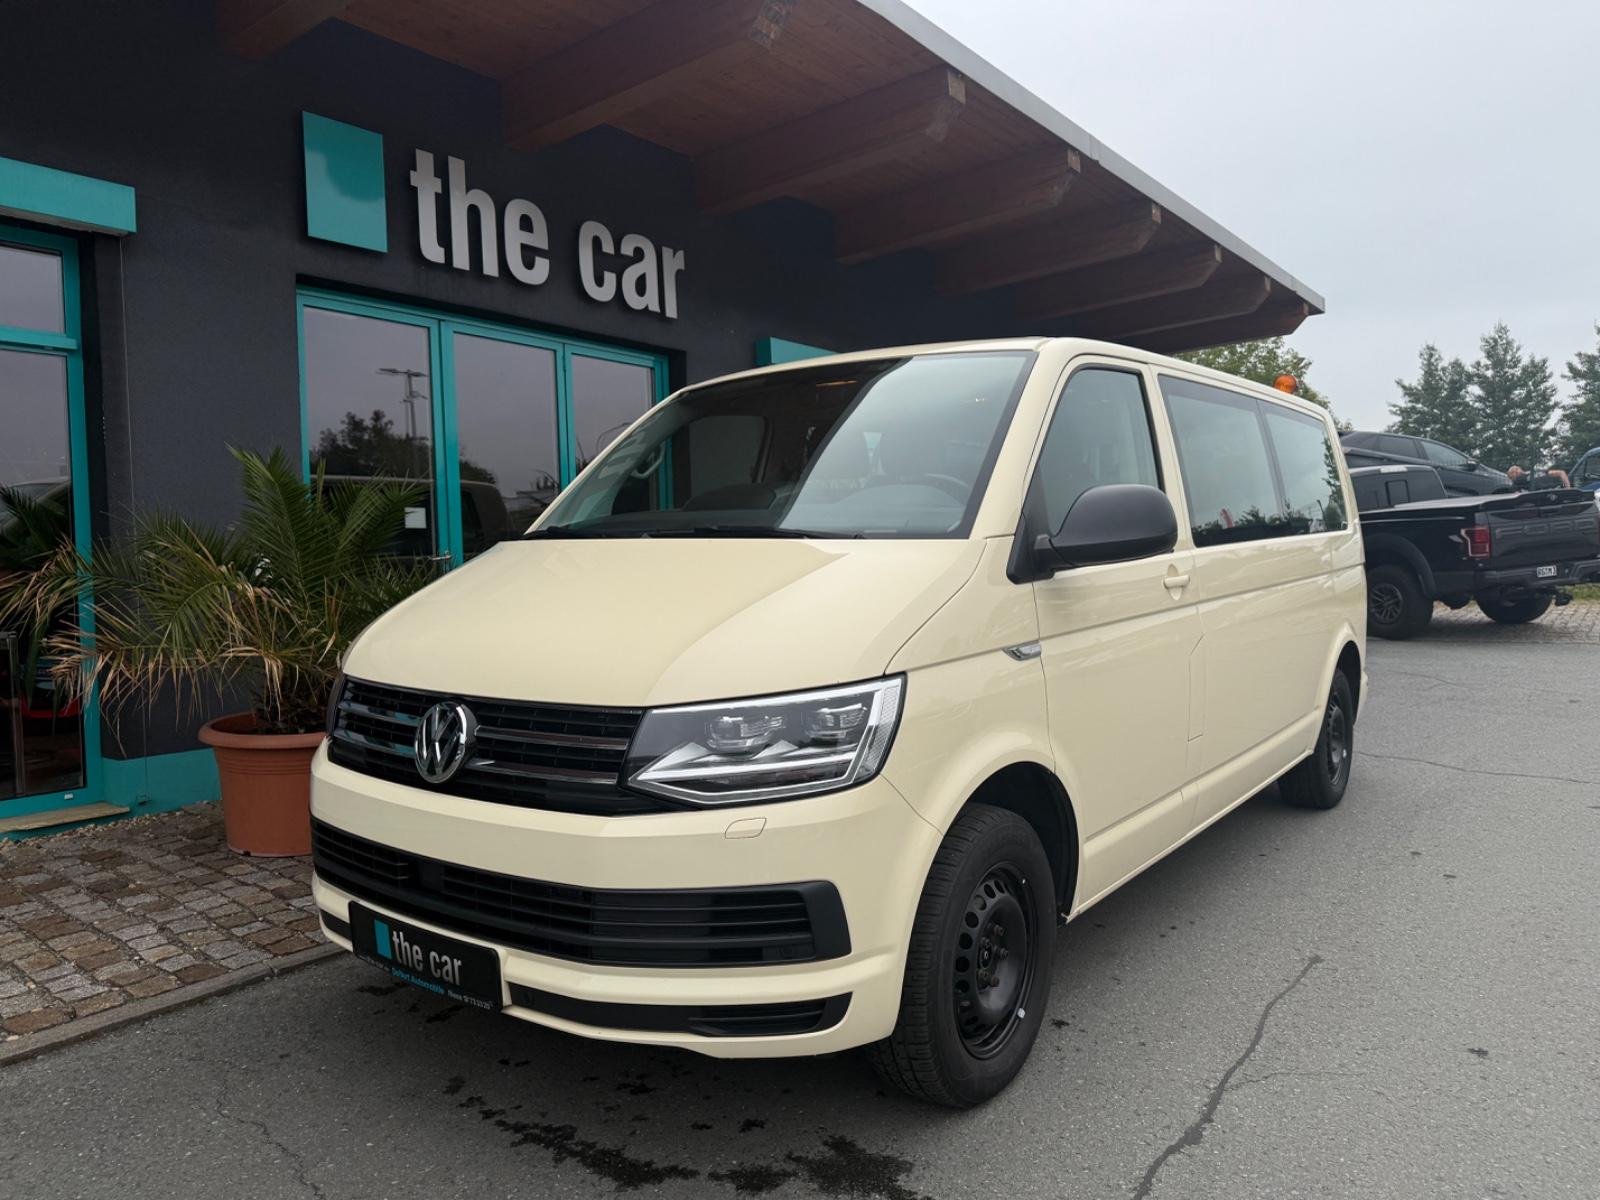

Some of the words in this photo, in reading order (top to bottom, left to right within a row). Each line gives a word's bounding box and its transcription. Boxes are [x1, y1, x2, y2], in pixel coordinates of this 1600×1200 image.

[410, 148, 550, 286] the
[578, 220, 685, 319] car
[392, 930, 424, 972] the
[429, 951, 462, 986] car
